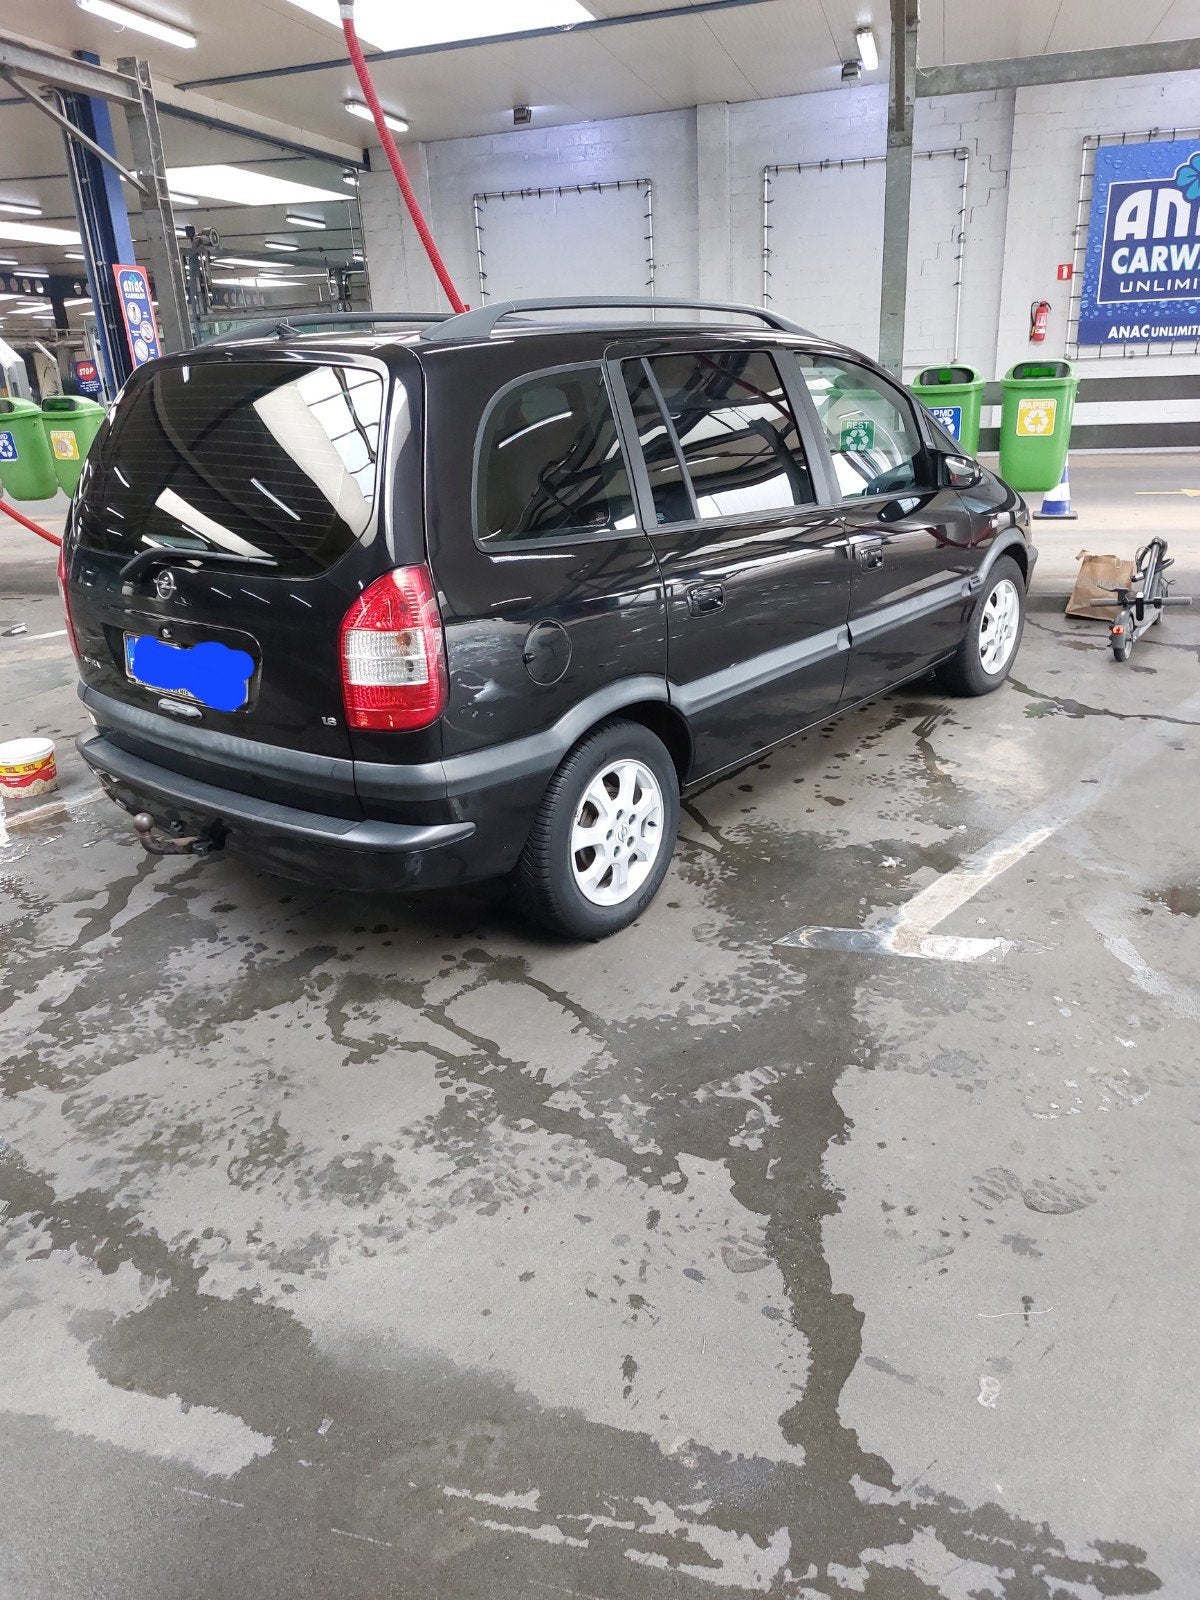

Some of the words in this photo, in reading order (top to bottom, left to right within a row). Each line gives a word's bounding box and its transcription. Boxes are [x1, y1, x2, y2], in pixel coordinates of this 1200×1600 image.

[1113, 188, 1200, 241] AN
[1111, 243, 1200, 275] CARW
[79, 367, 94, 376] STOP
[1020, 401, 1054, 409] PAPIER
[933, 409, 954, 417] PMD
[846, 421, 869, 429] REST
